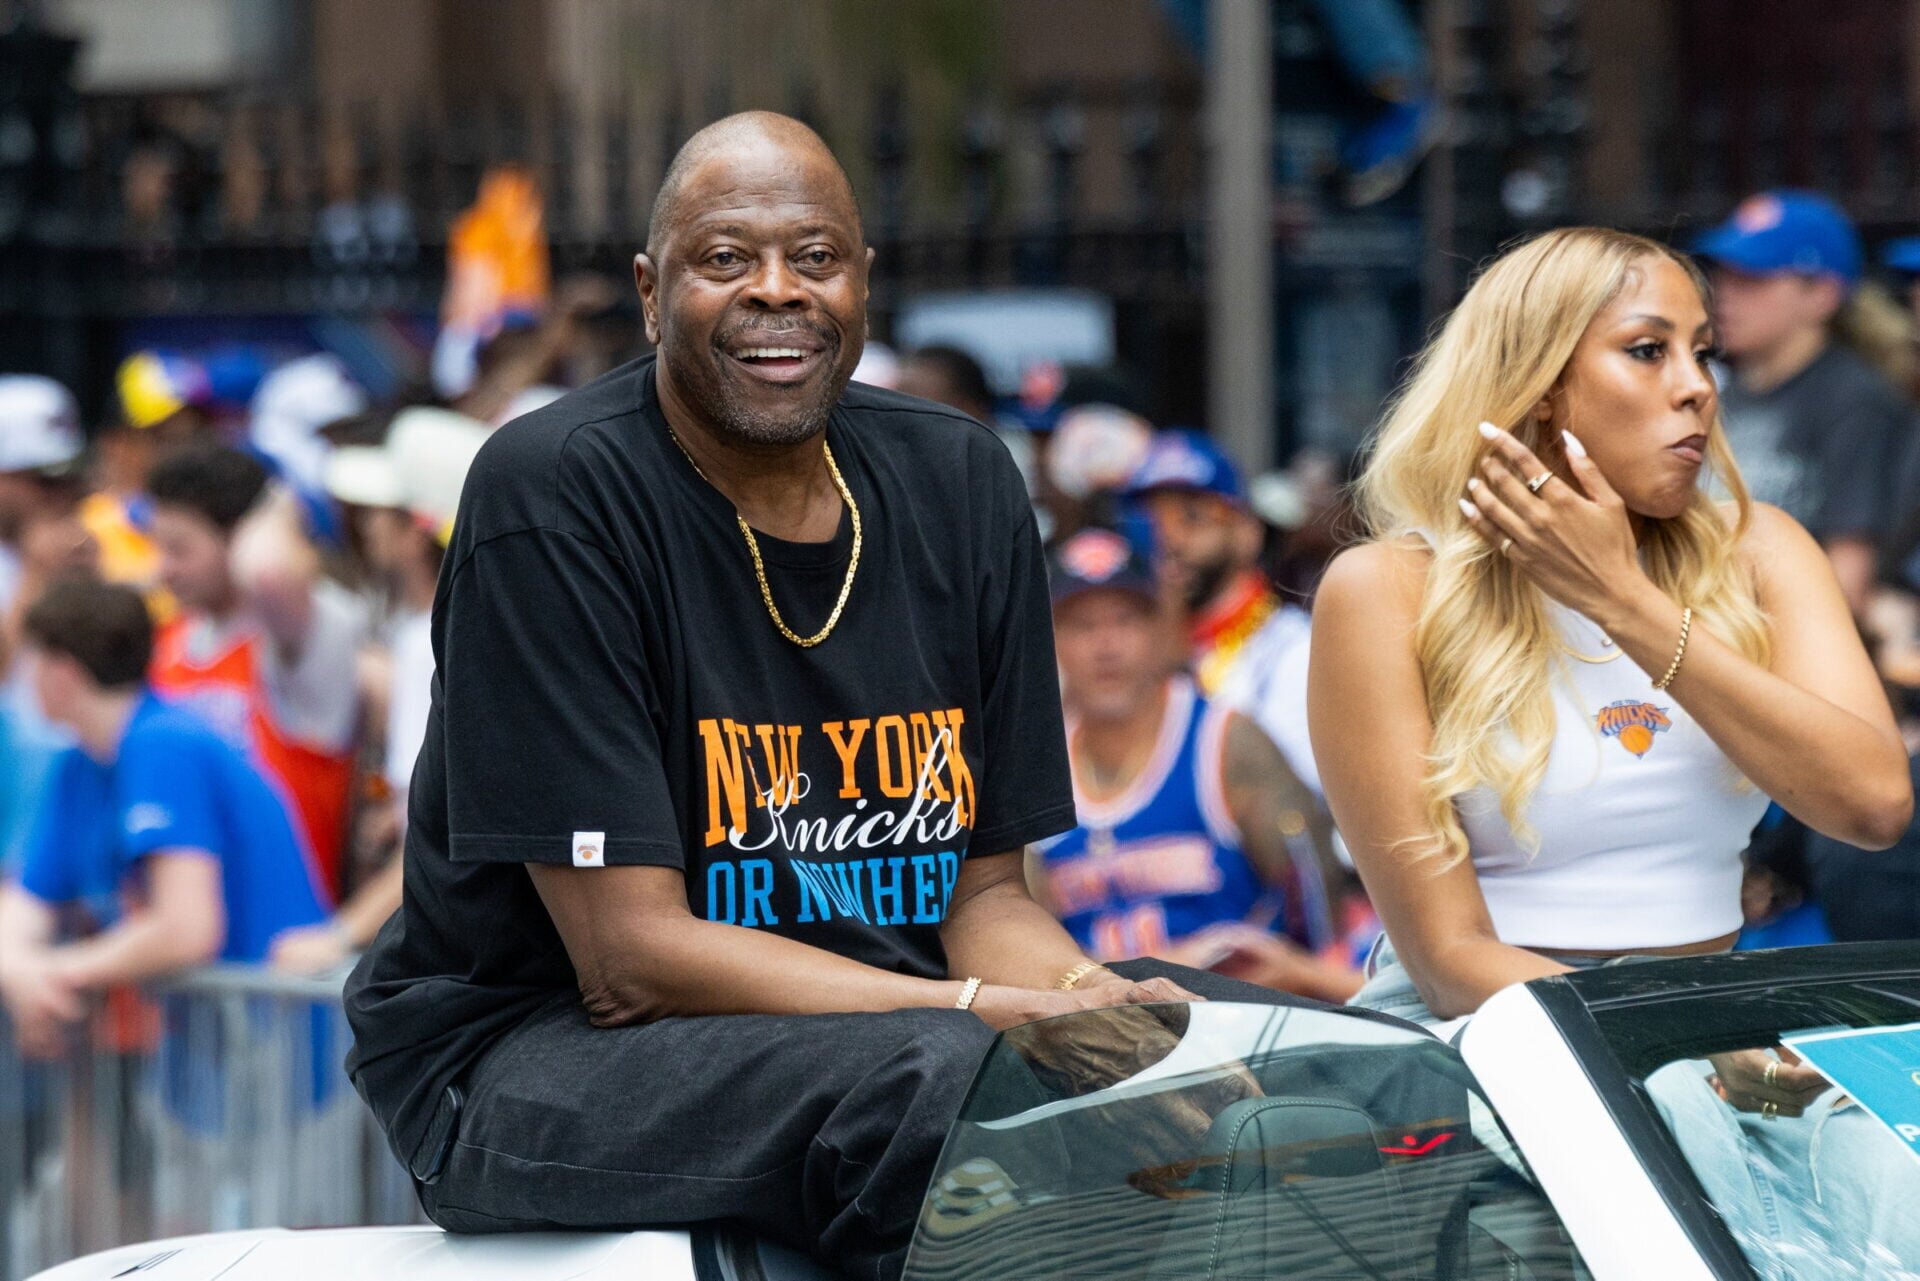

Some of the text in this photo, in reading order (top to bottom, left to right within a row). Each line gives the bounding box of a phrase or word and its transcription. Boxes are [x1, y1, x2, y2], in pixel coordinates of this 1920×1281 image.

[1597, 702, 1672, 733] KNICKS
[729, 728, 968, 852] Knicks
[822, 708, 976, 830] YORK
[707, 859, 778, 926] OR
[790, 849, 967, 926] NOWHER
